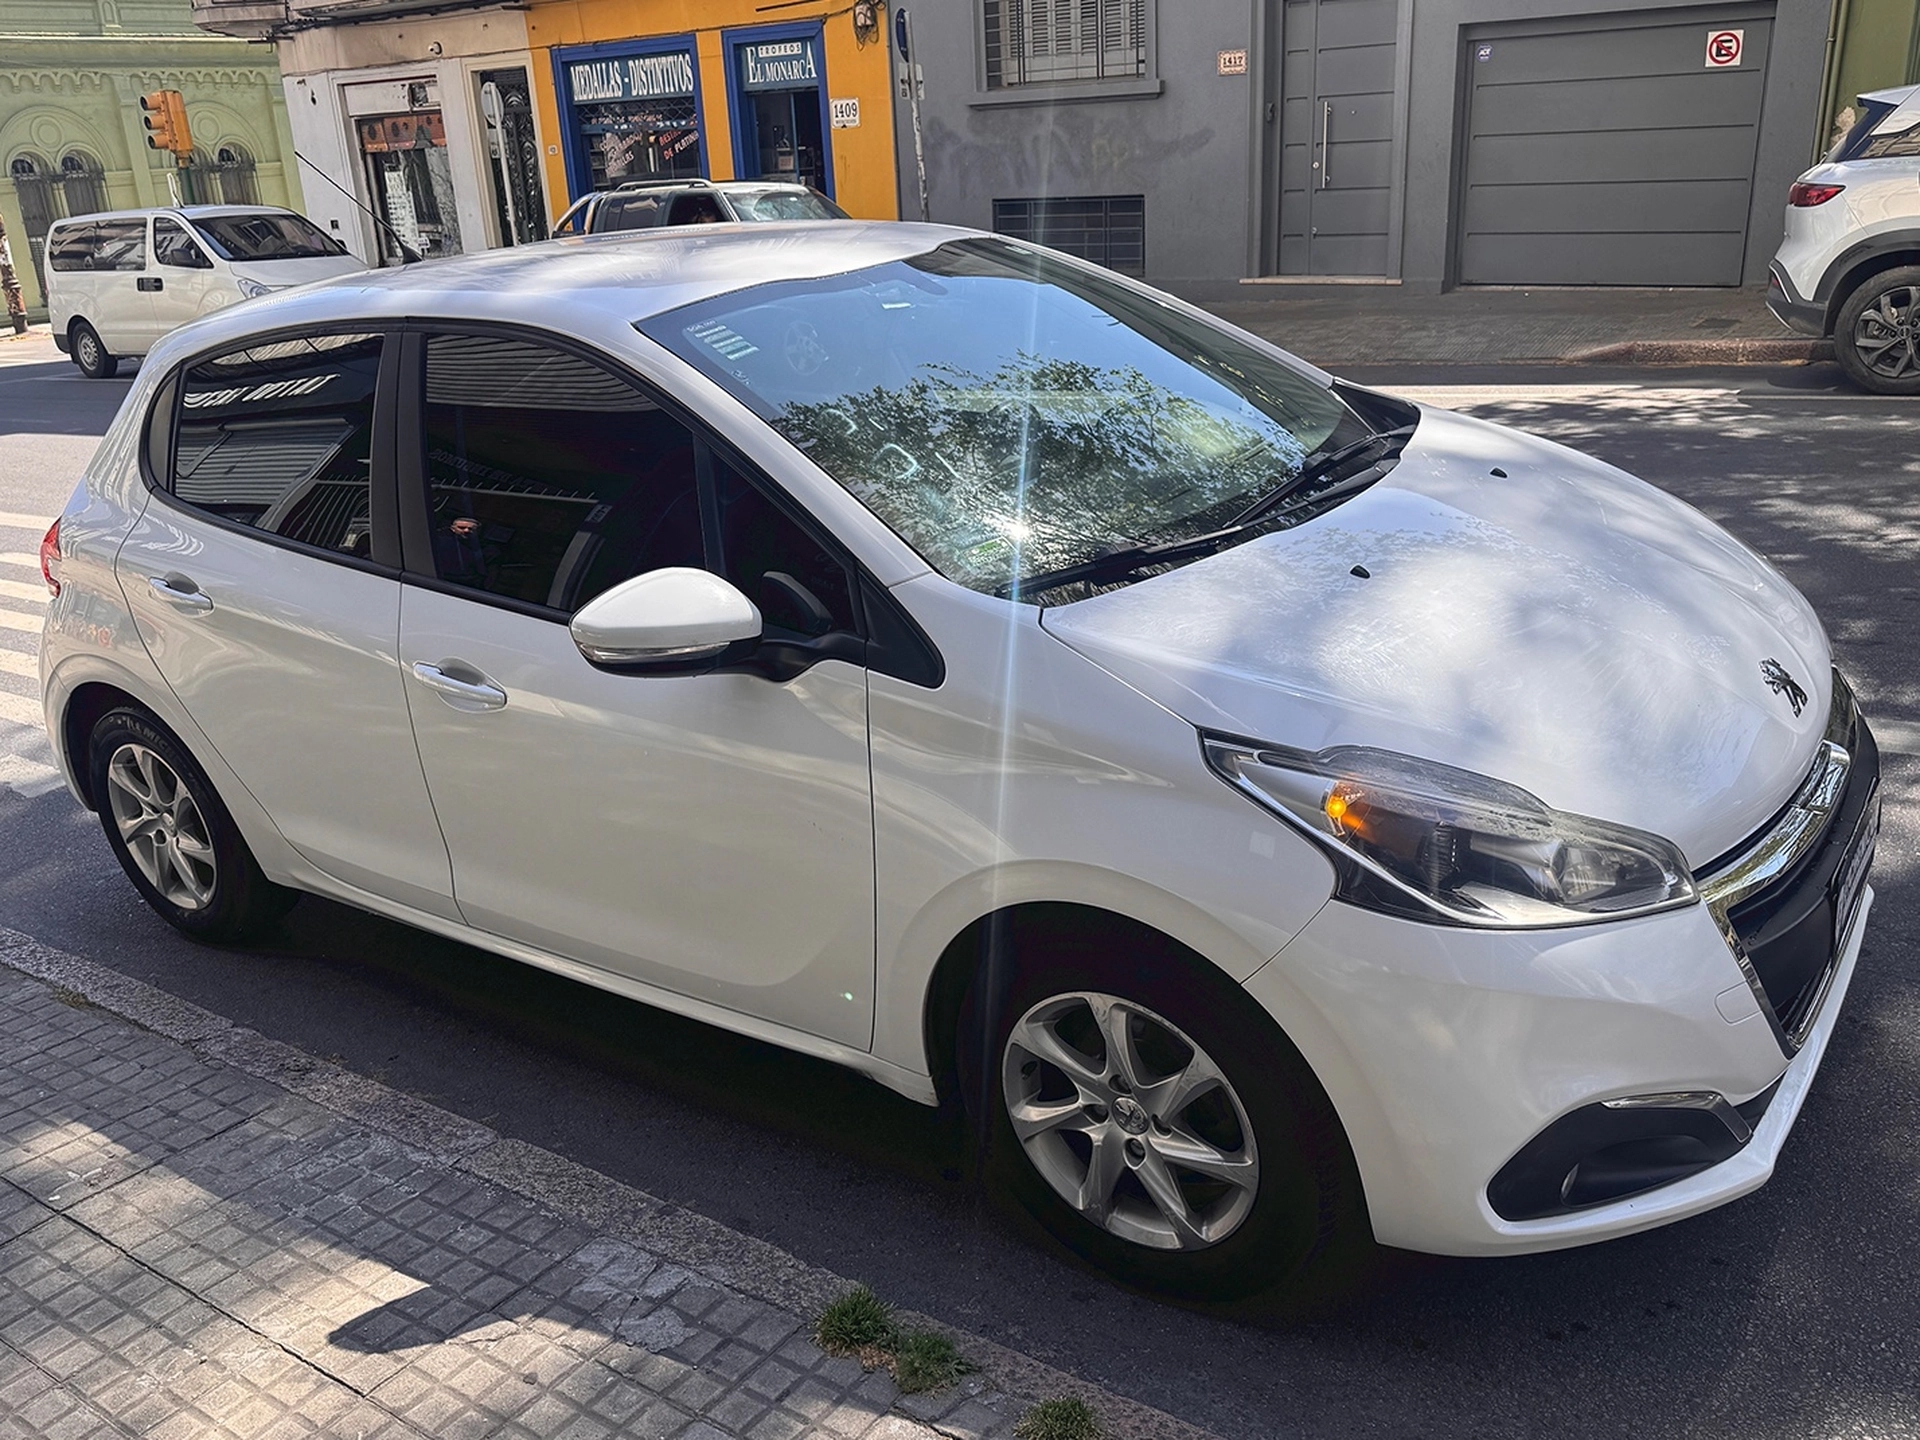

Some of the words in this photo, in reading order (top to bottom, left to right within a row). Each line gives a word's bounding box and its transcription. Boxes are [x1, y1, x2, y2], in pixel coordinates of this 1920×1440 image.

[759, 43, 800, 56] TROFEOS
[765, 41, 817, 82] MONARCA
[570, 60, 623, 101] MEDALLAS
[627, 53, 694, 97] DISTINTIVOS
[833, 102, 858, 118] 1409
